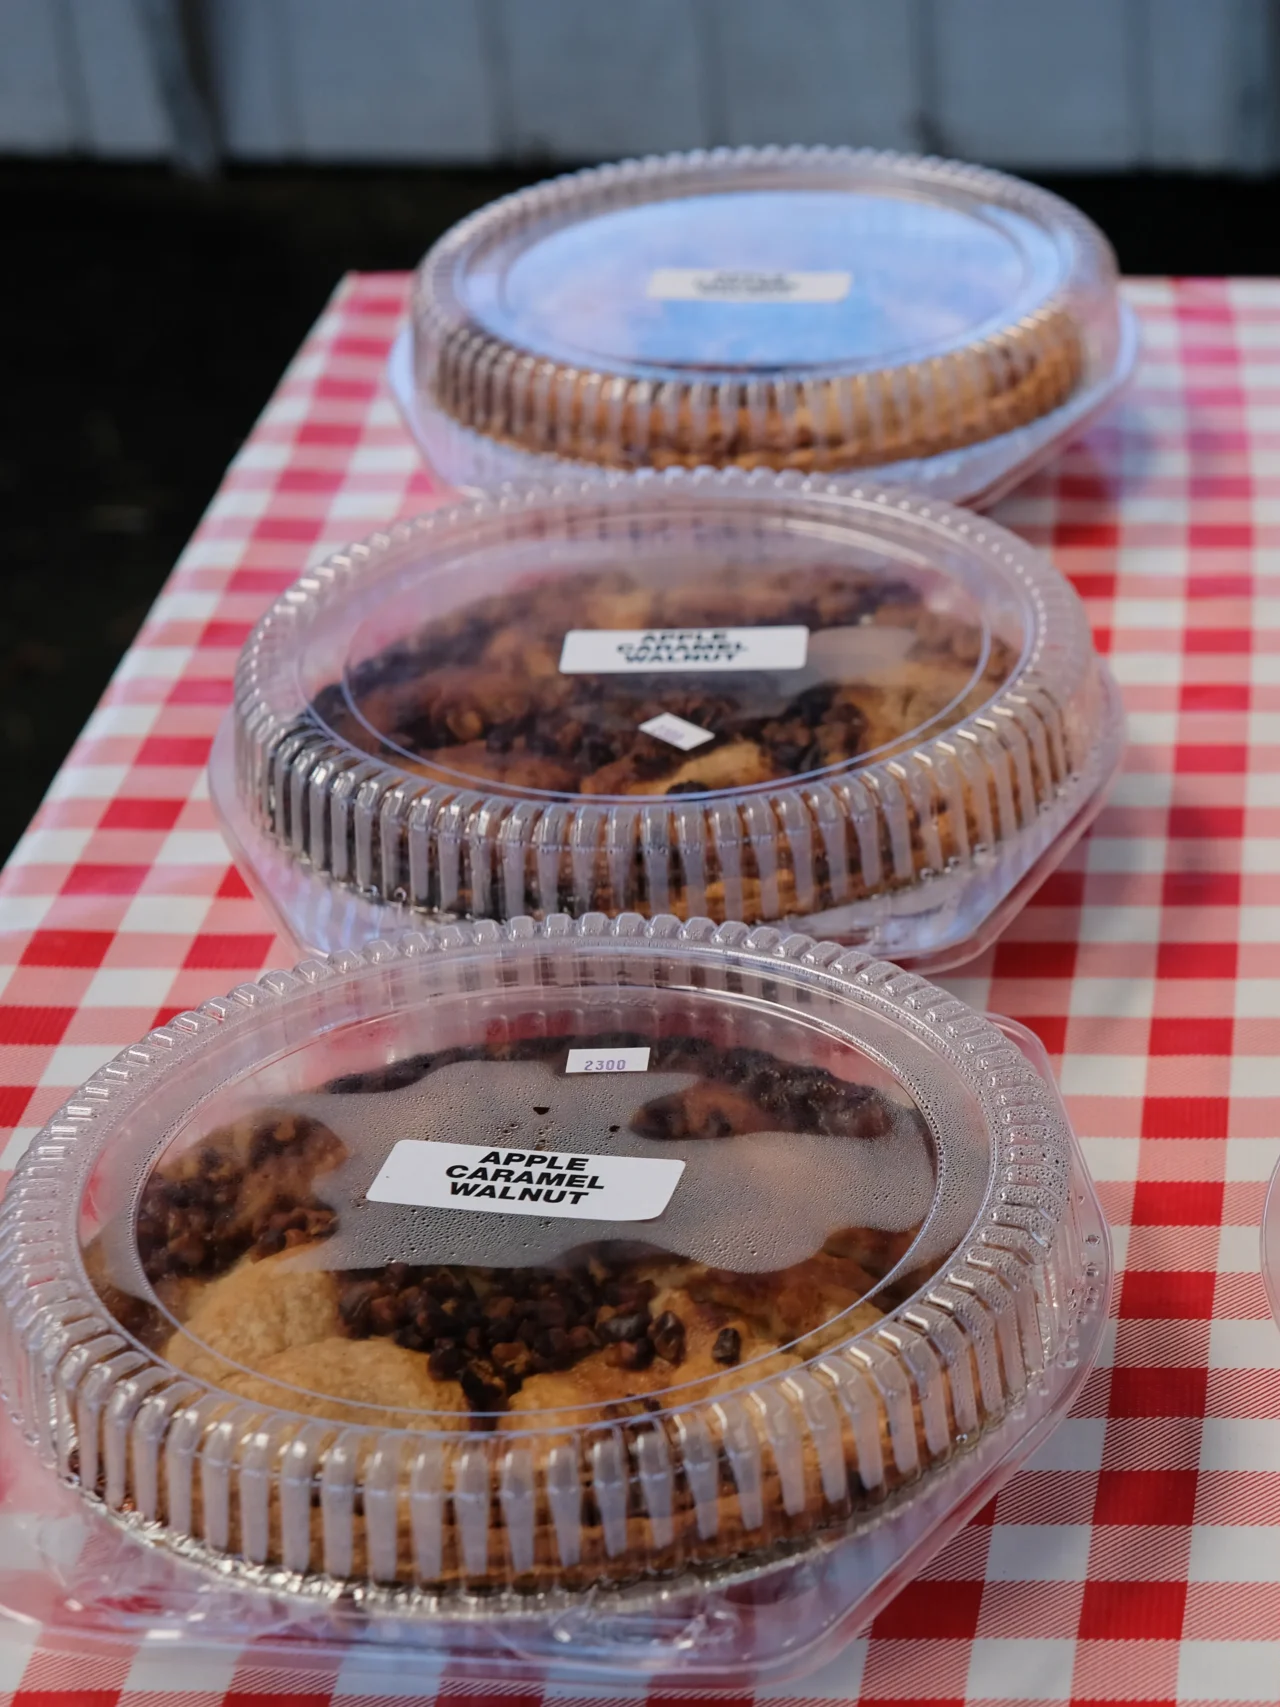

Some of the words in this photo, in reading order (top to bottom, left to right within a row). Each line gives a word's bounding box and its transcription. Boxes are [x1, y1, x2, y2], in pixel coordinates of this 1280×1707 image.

[641, 631, 728, 642] APPLE
[616, 641, 747, 654] CARAMEL
[625, 652, 737, 663] WALNUT
[584, 1060, 626, 1071] 2300
[478, 1151, 590, 1172] APPLE
[445, 1164, 605, 1190] CARAMEL
[450, 1181, 589, 1205] WALNUT
